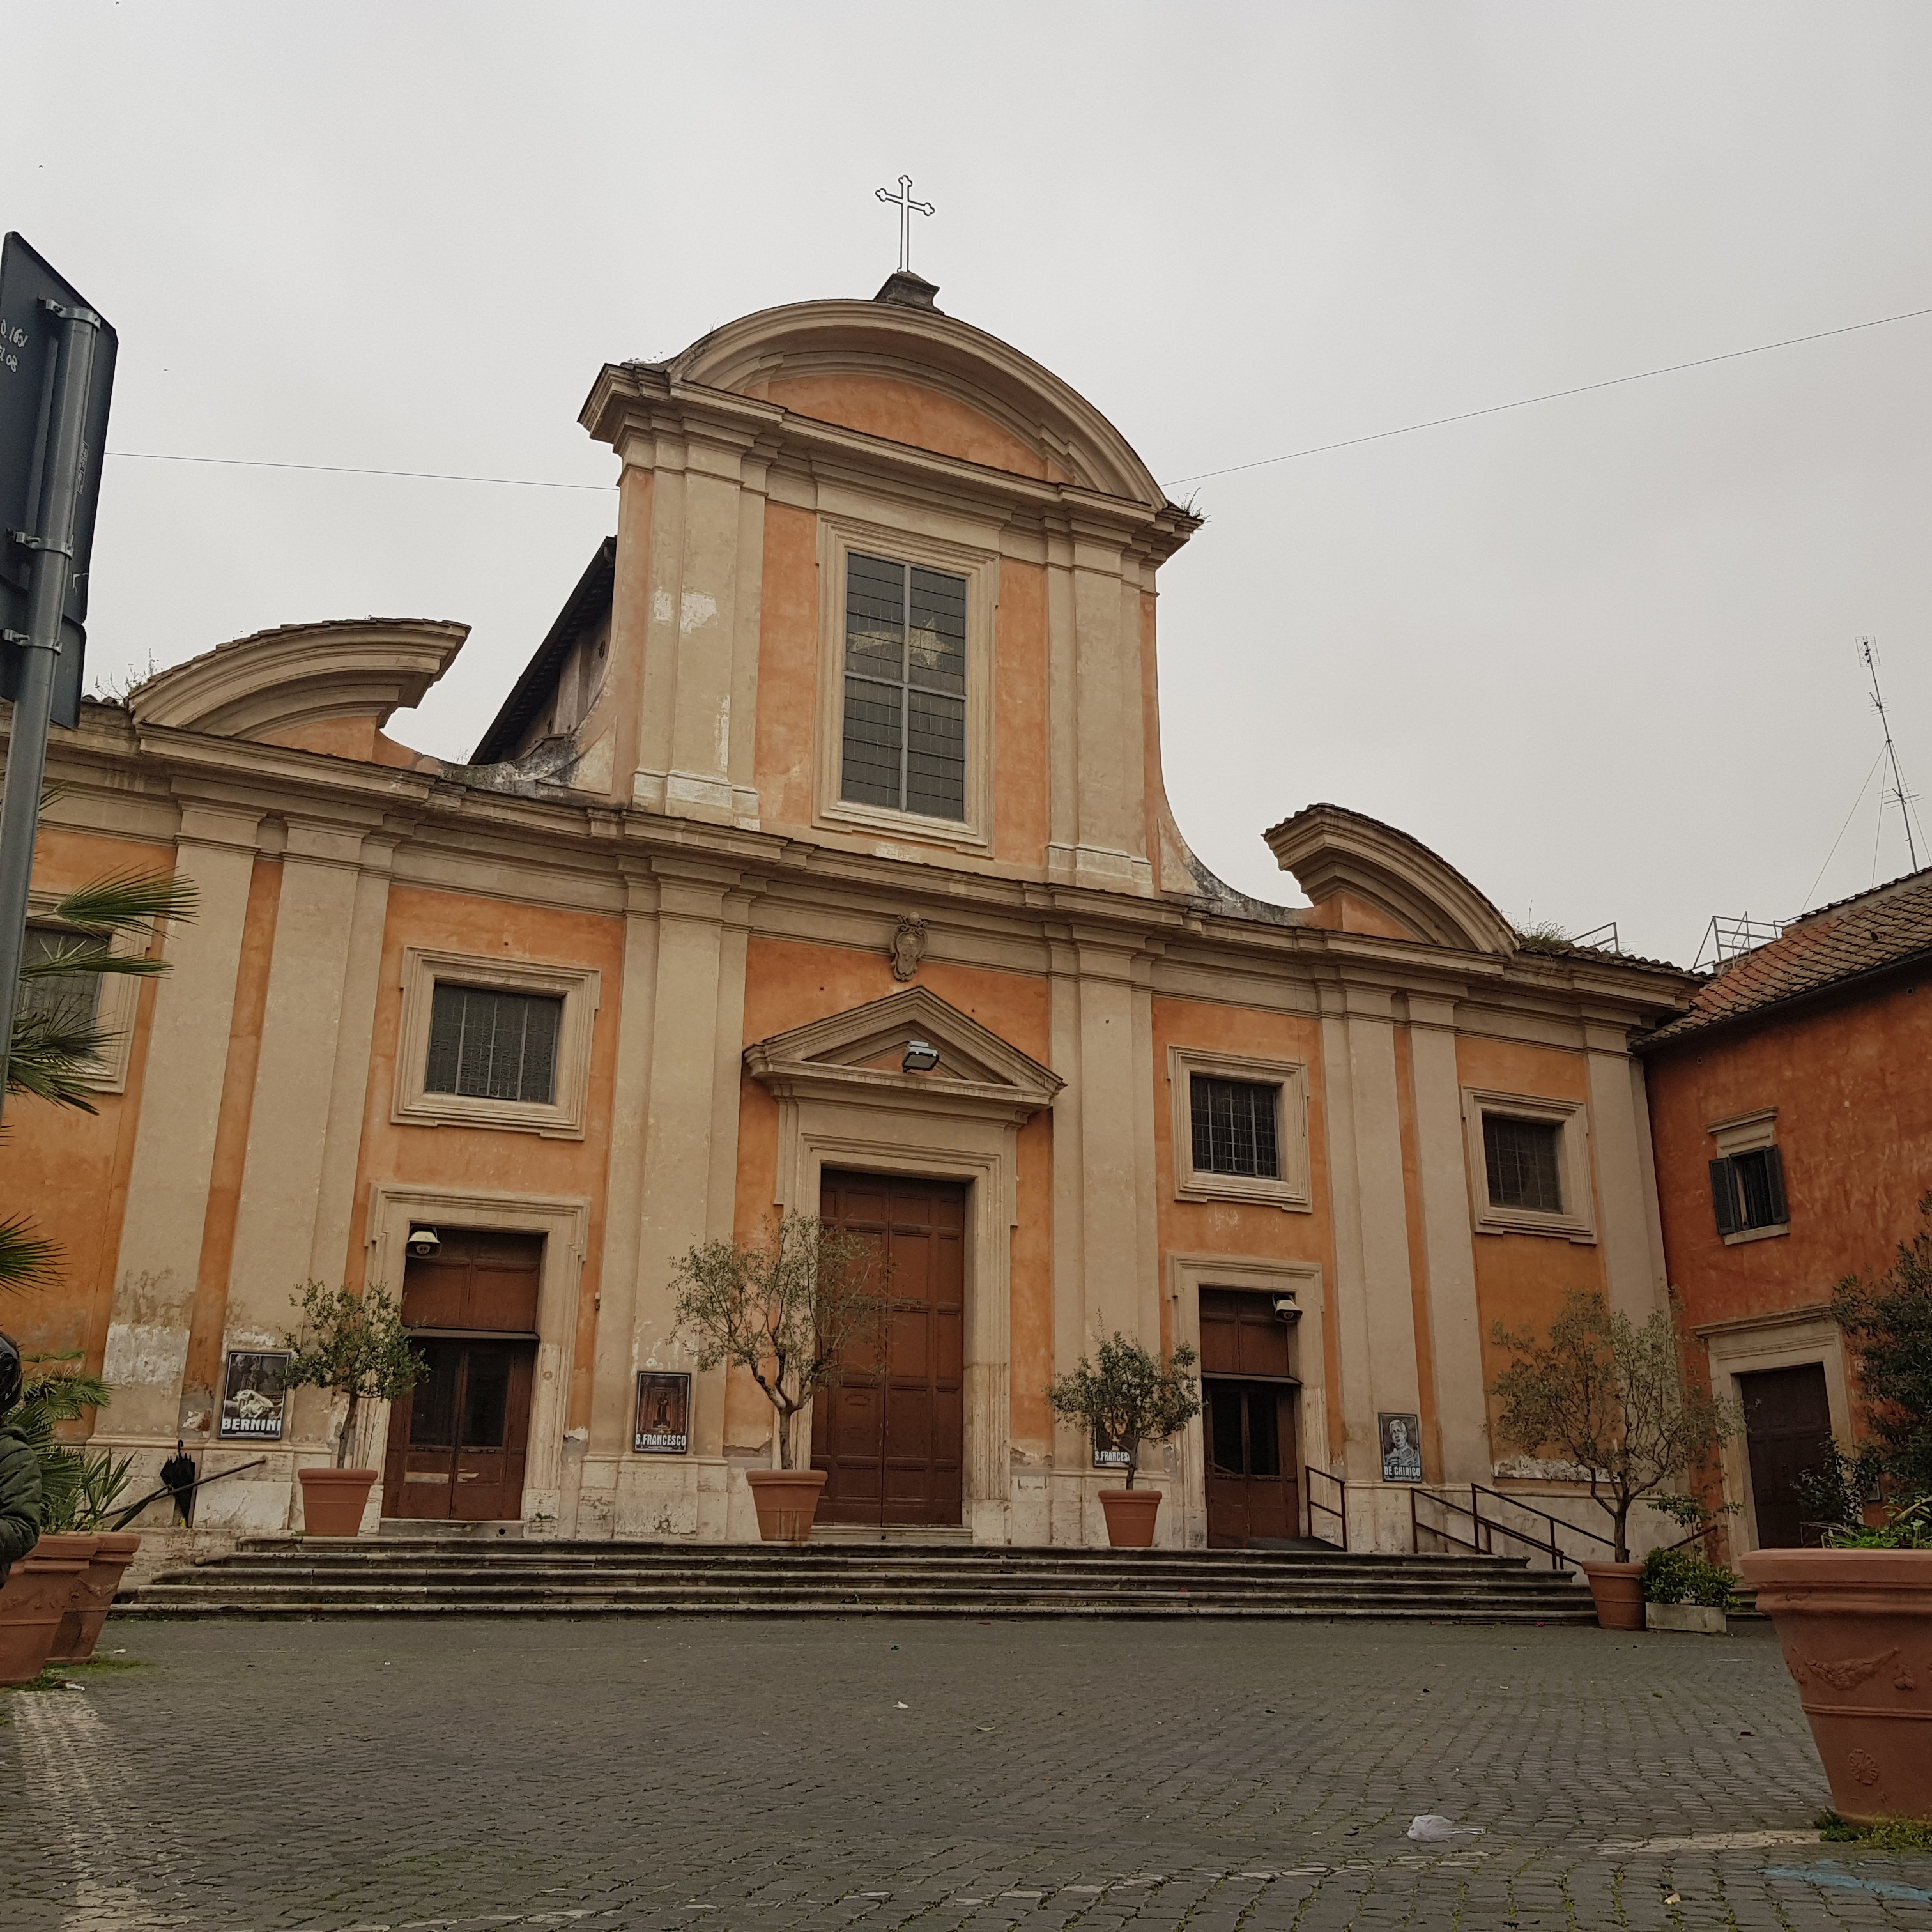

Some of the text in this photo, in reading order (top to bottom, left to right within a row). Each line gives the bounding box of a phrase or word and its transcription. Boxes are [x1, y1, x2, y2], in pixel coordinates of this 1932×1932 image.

[222, 1418, 281, 1431] BERNINI
[636, 1434, 686, 1446] S.FRANCESCO
[1384, 1466, 1420, 1476] DE CHIRICO
